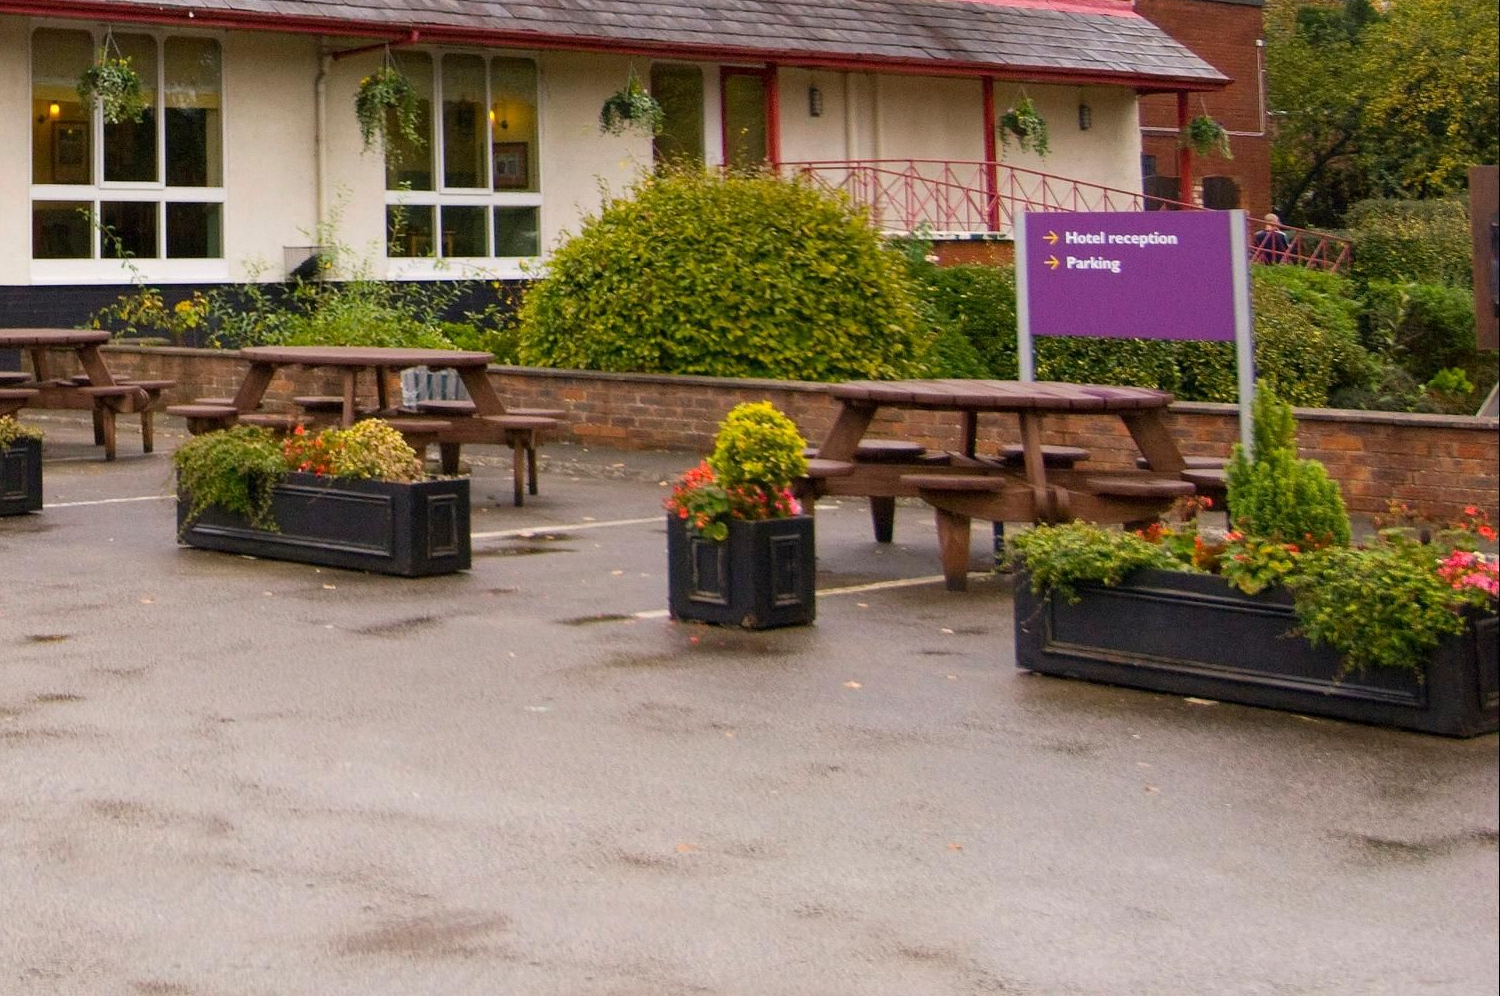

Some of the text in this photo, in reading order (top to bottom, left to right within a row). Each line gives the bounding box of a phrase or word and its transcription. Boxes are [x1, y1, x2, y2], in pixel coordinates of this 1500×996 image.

[1065, 231, 1179, 248] Hotel reception
[1066, 256, 1122, 274] Parking
